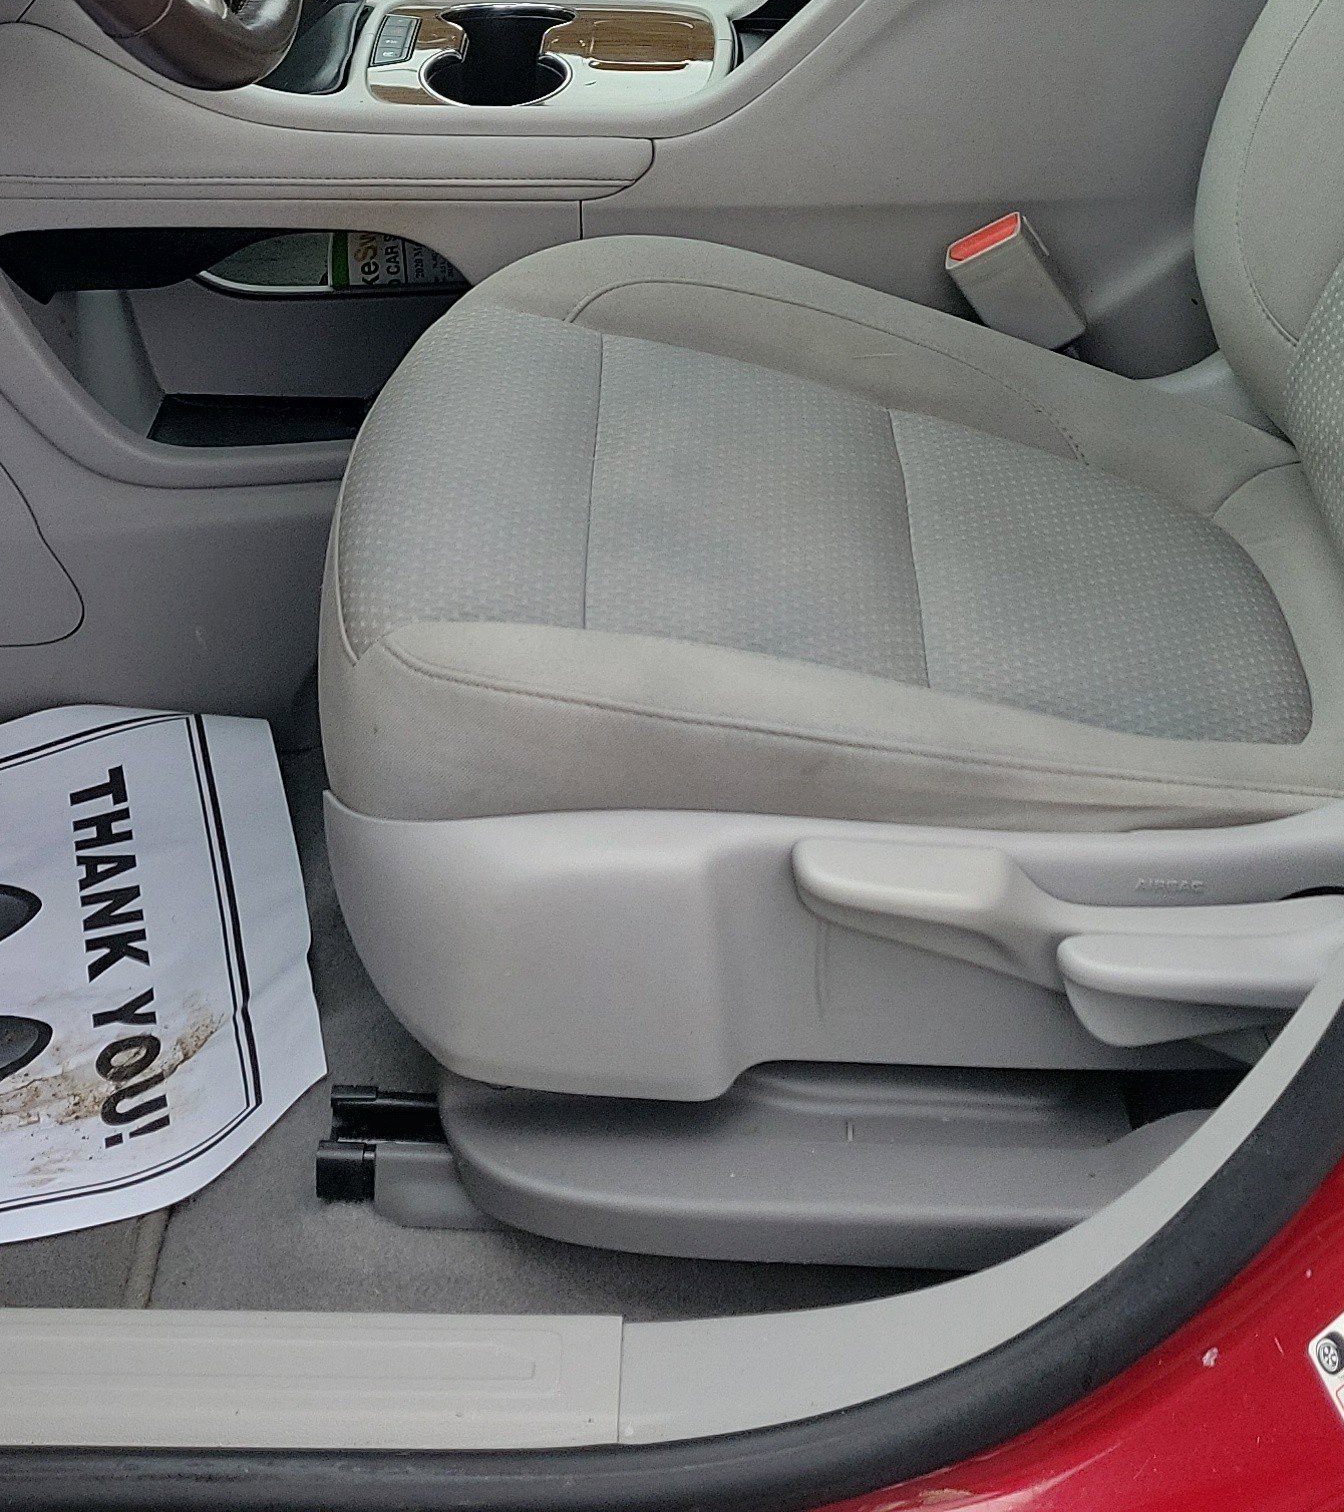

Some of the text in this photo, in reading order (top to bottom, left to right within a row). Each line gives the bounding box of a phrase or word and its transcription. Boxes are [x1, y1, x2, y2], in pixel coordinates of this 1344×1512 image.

[384, 245, 400, 275] CAR
[69, 765, 171, 1149] THANK YOU!
